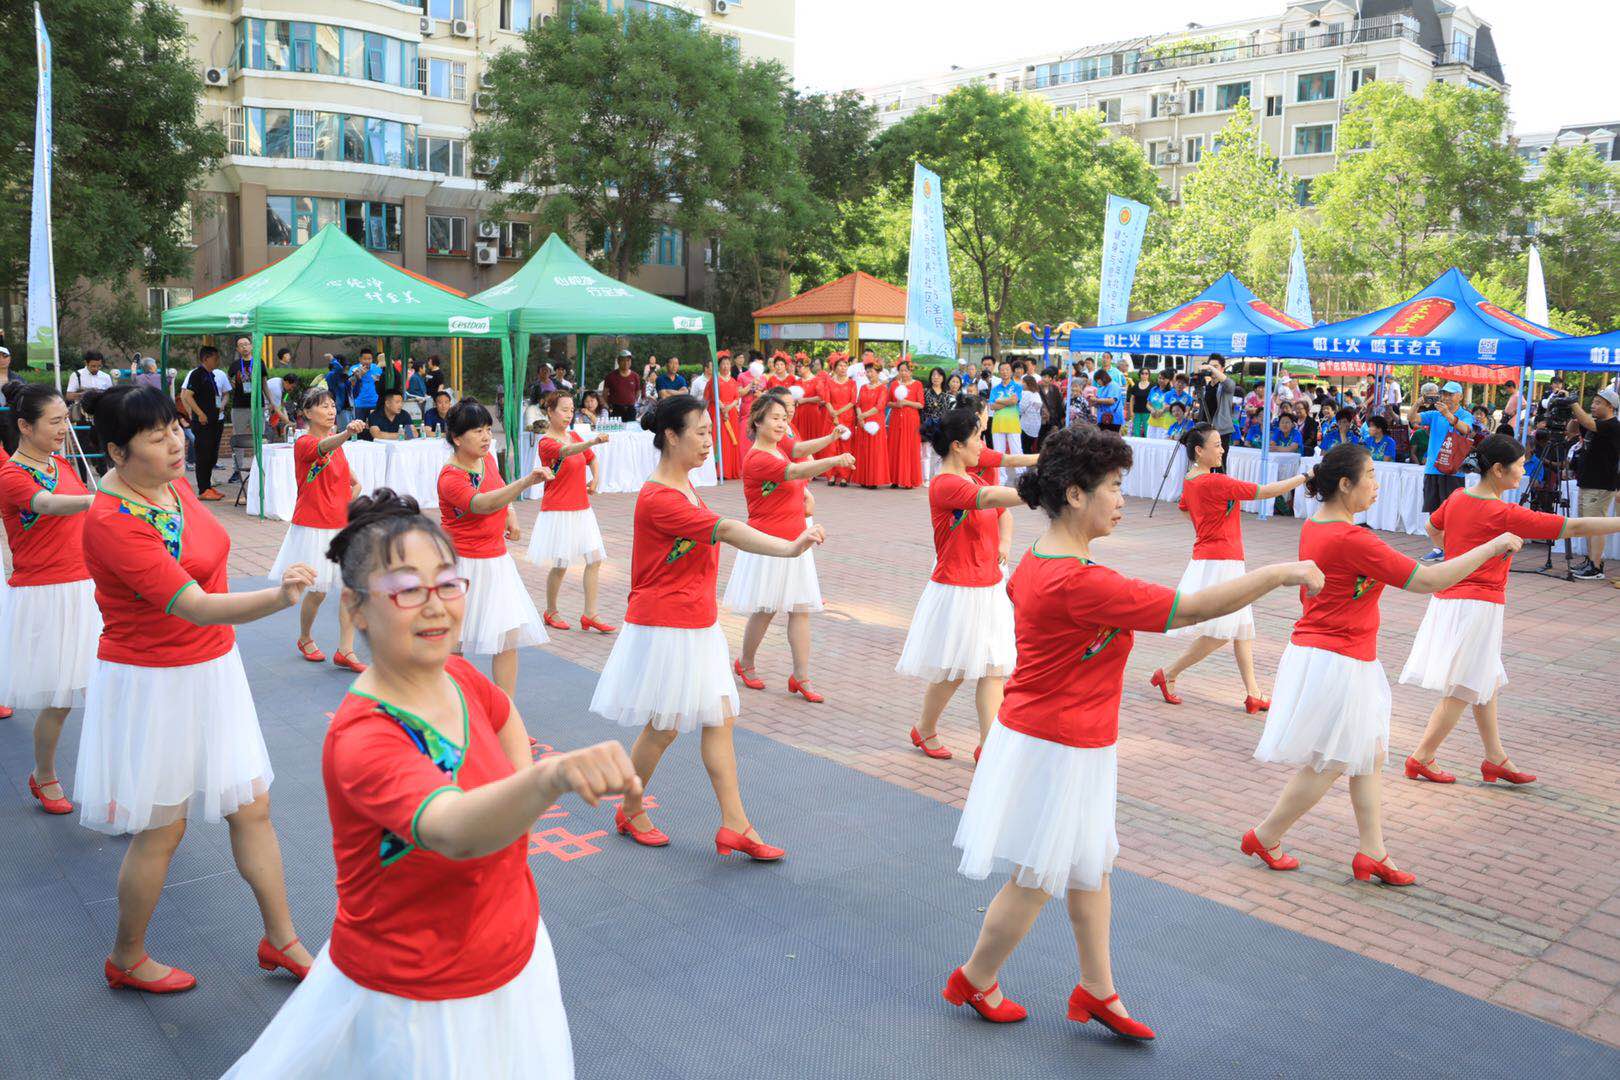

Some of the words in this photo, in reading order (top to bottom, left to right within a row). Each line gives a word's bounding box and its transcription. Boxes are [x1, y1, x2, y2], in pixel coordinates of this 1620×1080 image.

[1103, 334, 1141, 348] 怕上火
[1148, 334, 1204, 349] 喝王老吉
[1312, 336, 1360, 353] 怕上火
[1370, 338, 1442, 357] 喝王老吉
